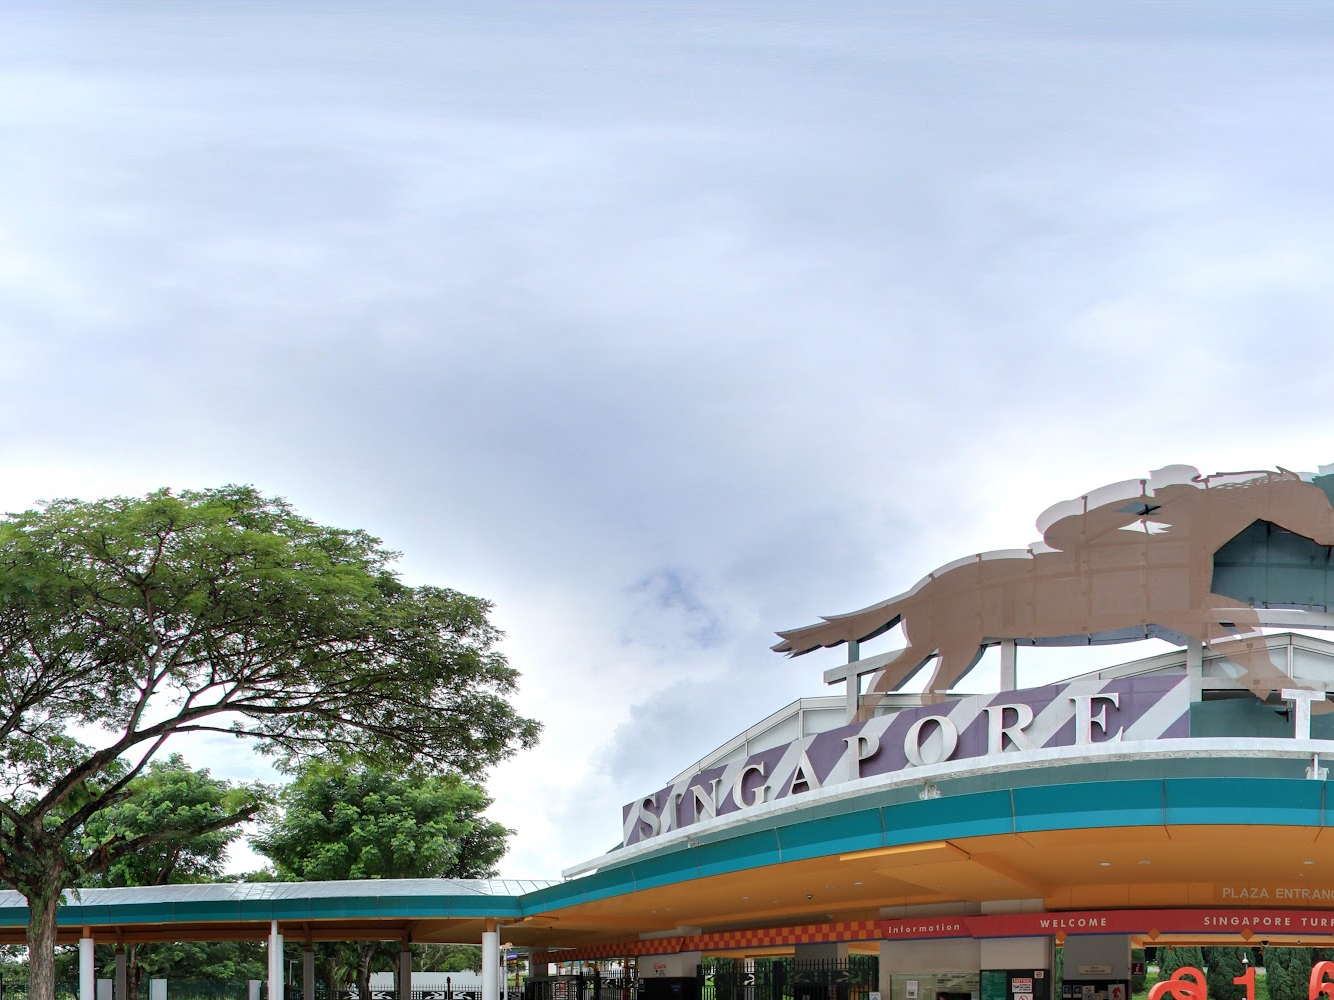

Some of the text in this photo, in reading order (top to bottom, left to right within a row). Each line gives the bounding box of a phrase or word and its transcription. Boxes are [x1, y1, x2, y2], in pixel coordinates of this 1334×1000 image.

[637, 692, 1124, 840] SINGAPORE
[1222, 887, 1269, 899] PLAZA
[1040, 917, 1107, 928] WELCOME
[1203, 916, 1291, 927] SINGAPORE
[888, 923, 961, 934] Information
